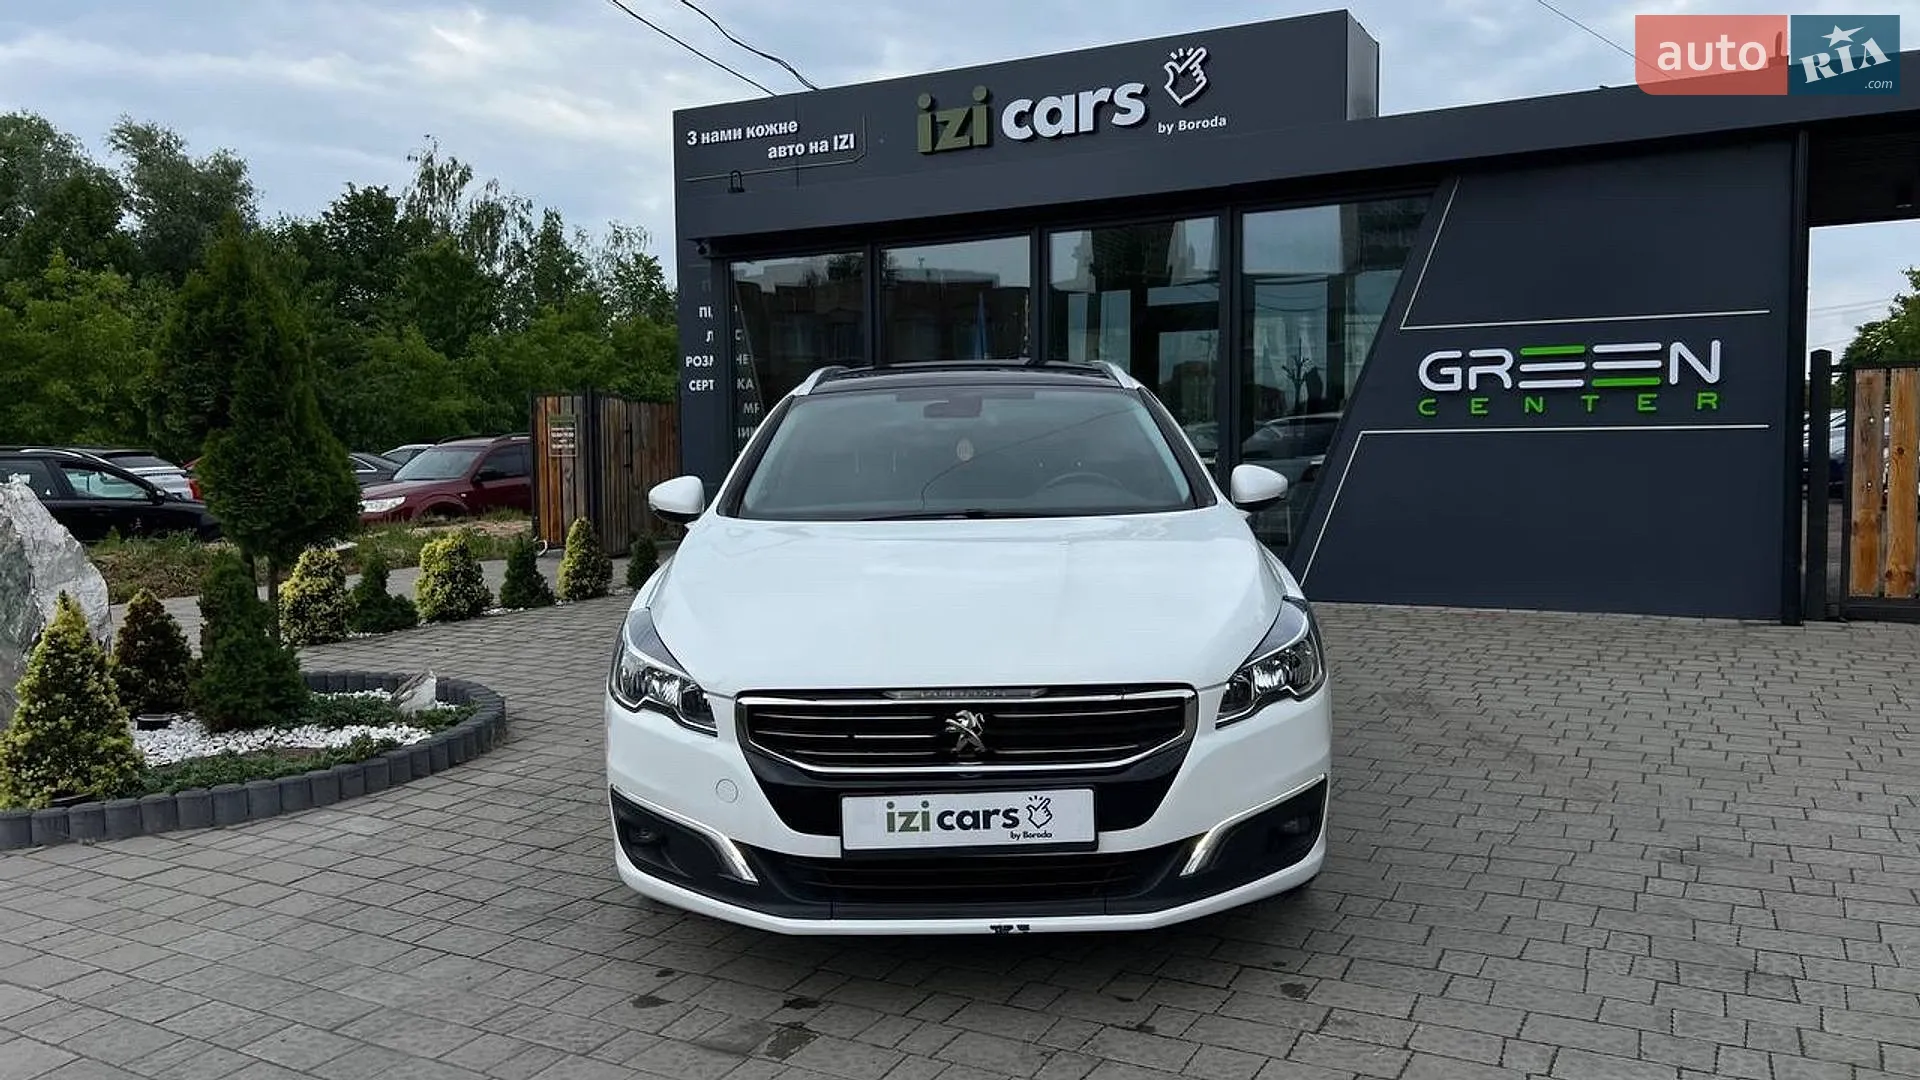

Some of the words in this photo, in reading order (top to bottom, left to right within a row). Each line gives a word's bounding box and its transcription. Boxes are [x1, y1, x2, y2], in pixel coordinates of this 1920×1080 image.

[917, 85, 988, 153] izi
[1001, 82, 1147, 140] cars
[1158, 120, 1174, 135] by
[1178, 115, 1227, 131] Boroda
[701, 126, 743, 145] нами
[746, 120, 798, 140] кожне
[767, 141, 806, 159] авто
[809, 139, 829, 155] на
[833, 133, 855, 151] IZI
[1418, 339, 1721, 391] GREEN
[1418, 392, 1719, 416] CENTER
[886, 800, 931, 833] izi
[937, 807, 1020, 831] cars
[1010, 830, 1021, 840] by
